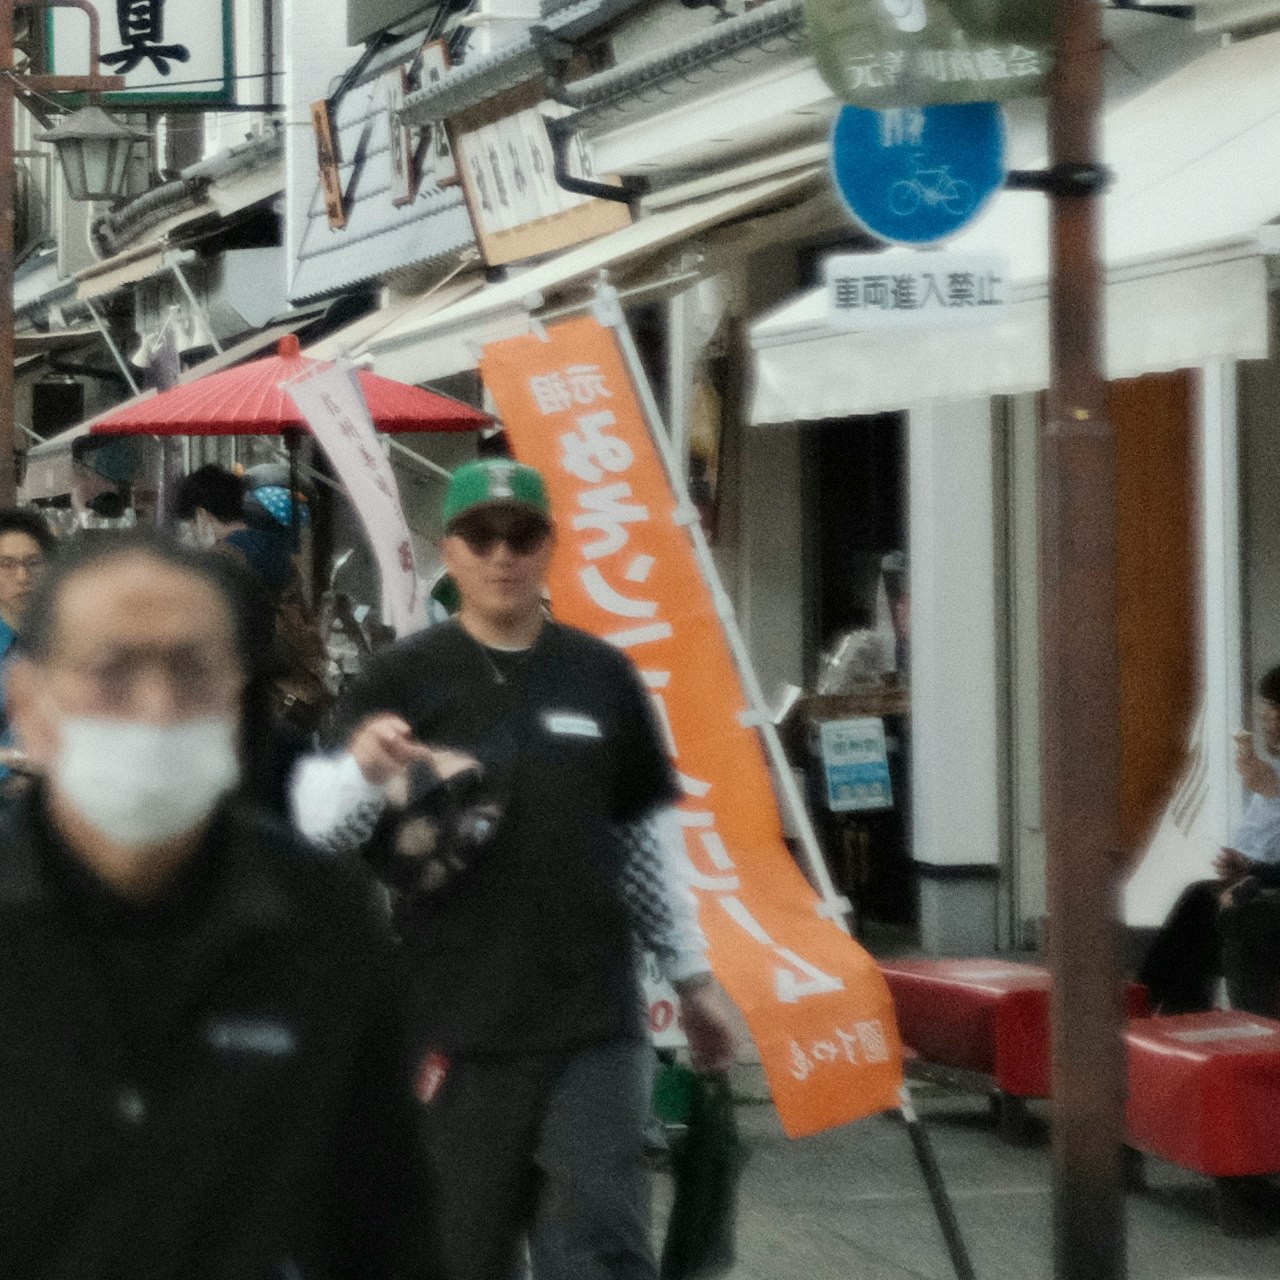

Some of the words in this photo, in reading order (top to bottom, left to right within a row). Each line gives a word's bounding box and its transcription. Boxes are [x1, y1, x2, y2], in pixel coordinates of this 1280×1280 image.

[833, 270, 1003, 311] 車両進入禁止
